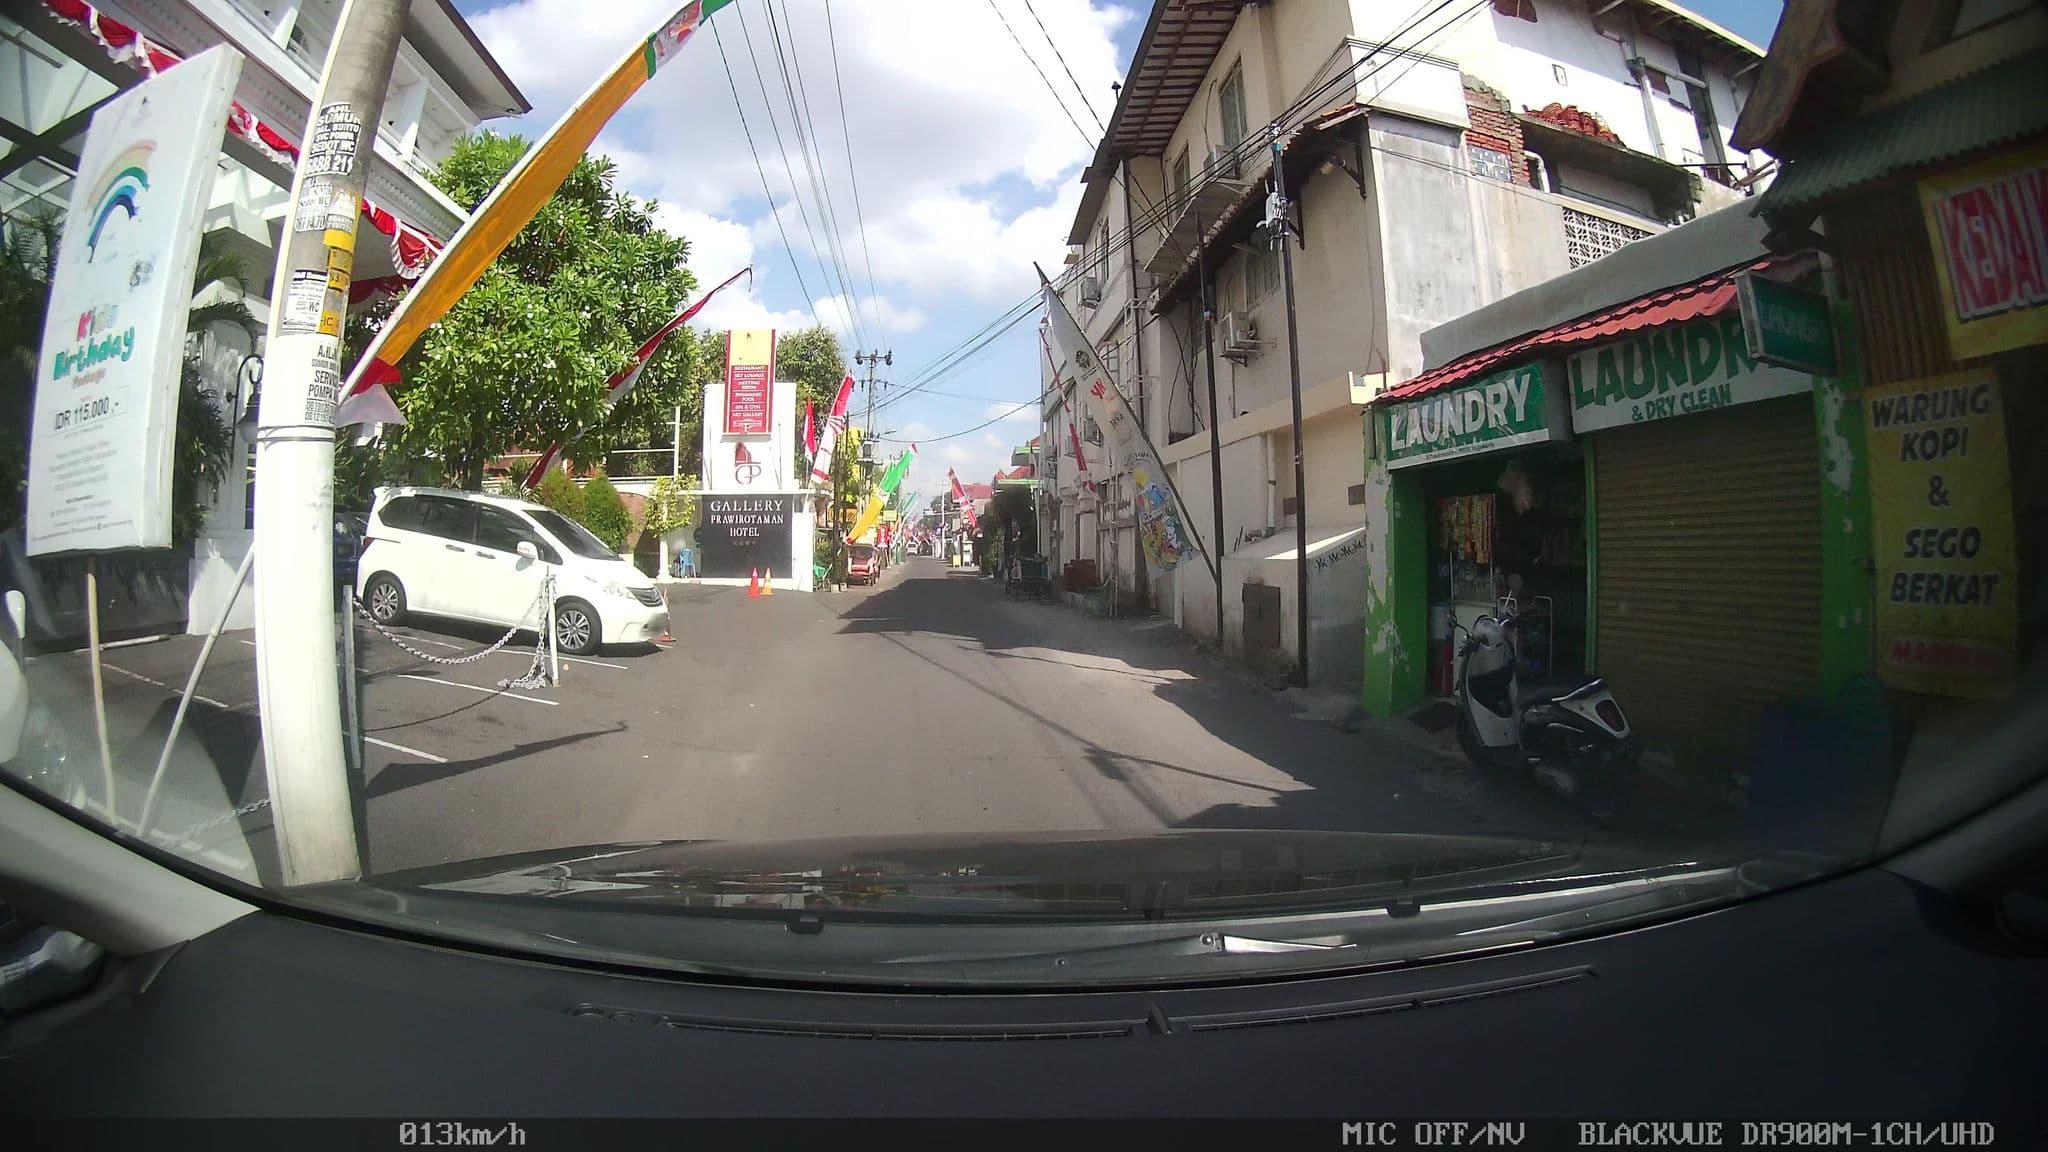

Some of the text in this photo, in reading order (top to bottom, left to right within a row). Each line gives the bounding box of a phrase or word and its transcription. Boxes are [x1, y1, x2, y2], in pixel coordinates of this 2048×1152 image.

[53, 326, 135, 381] Birthday
[1571, 319, 1759, 410] LAUNDR
[1391, 373, 1531, 450] LAUNDRY
[1632, 383, 1732, 422] & DRY CLEAN
[1871, 384, 1990, 427] WARUNG
[54, 410, 71, 431] IDR
[1901, 428, 1968, 462] KOPI
[710, 500, 784, 512] GALLERY
[1928, 475, 1951, 506] &
[710, 514, 784, 524] PRAWIROTAMAN
[729, 527, 760, 537] HOTEL
[1904, 527, 1980, 559] SEGO
[1890, 572, 1999, 607] BERKAT
